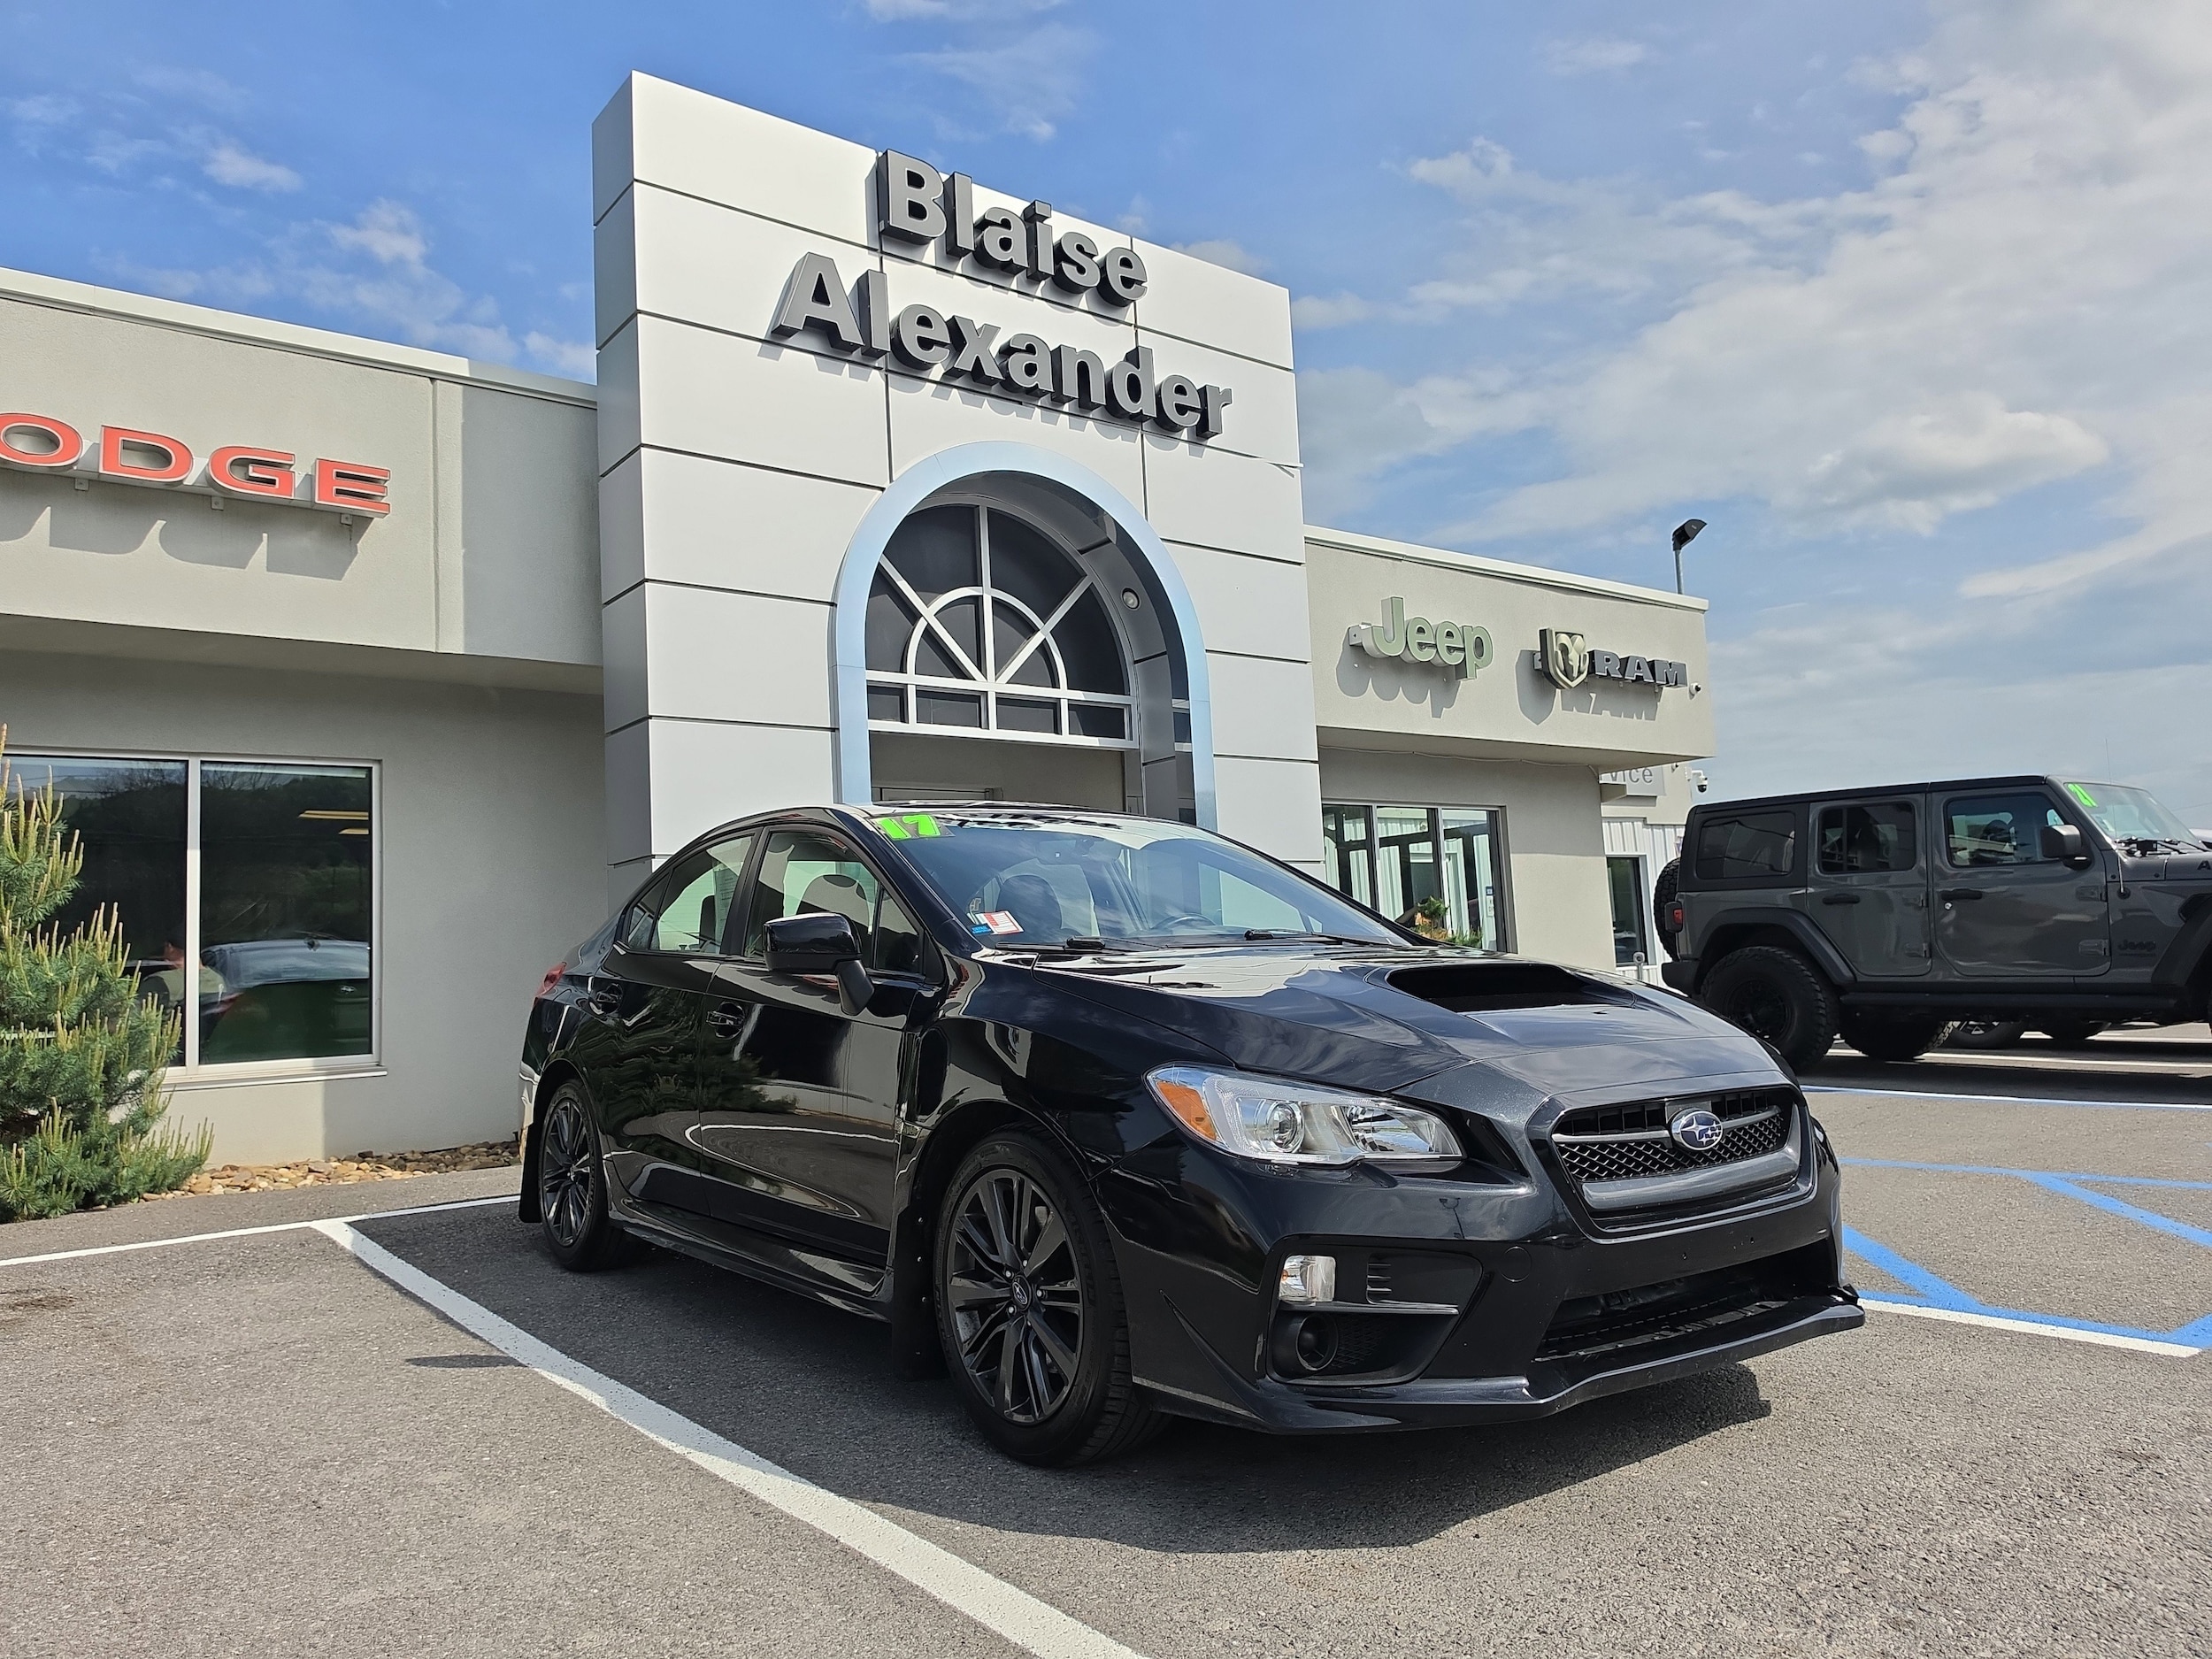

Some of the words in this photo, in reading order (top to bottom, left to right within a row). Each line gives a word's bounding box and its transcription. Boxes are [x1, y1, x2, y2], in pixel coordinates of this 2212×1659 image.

[879, 149, 1148, 308] Blaise
[772, 252, 1233, 440] Alexander
[1363, 596, 1494, 680] Jeep
[1590, 649, 1687, 687] RAM
[2067, 783, 2098, 808] 21
[877, 815, 941, 840] 17
